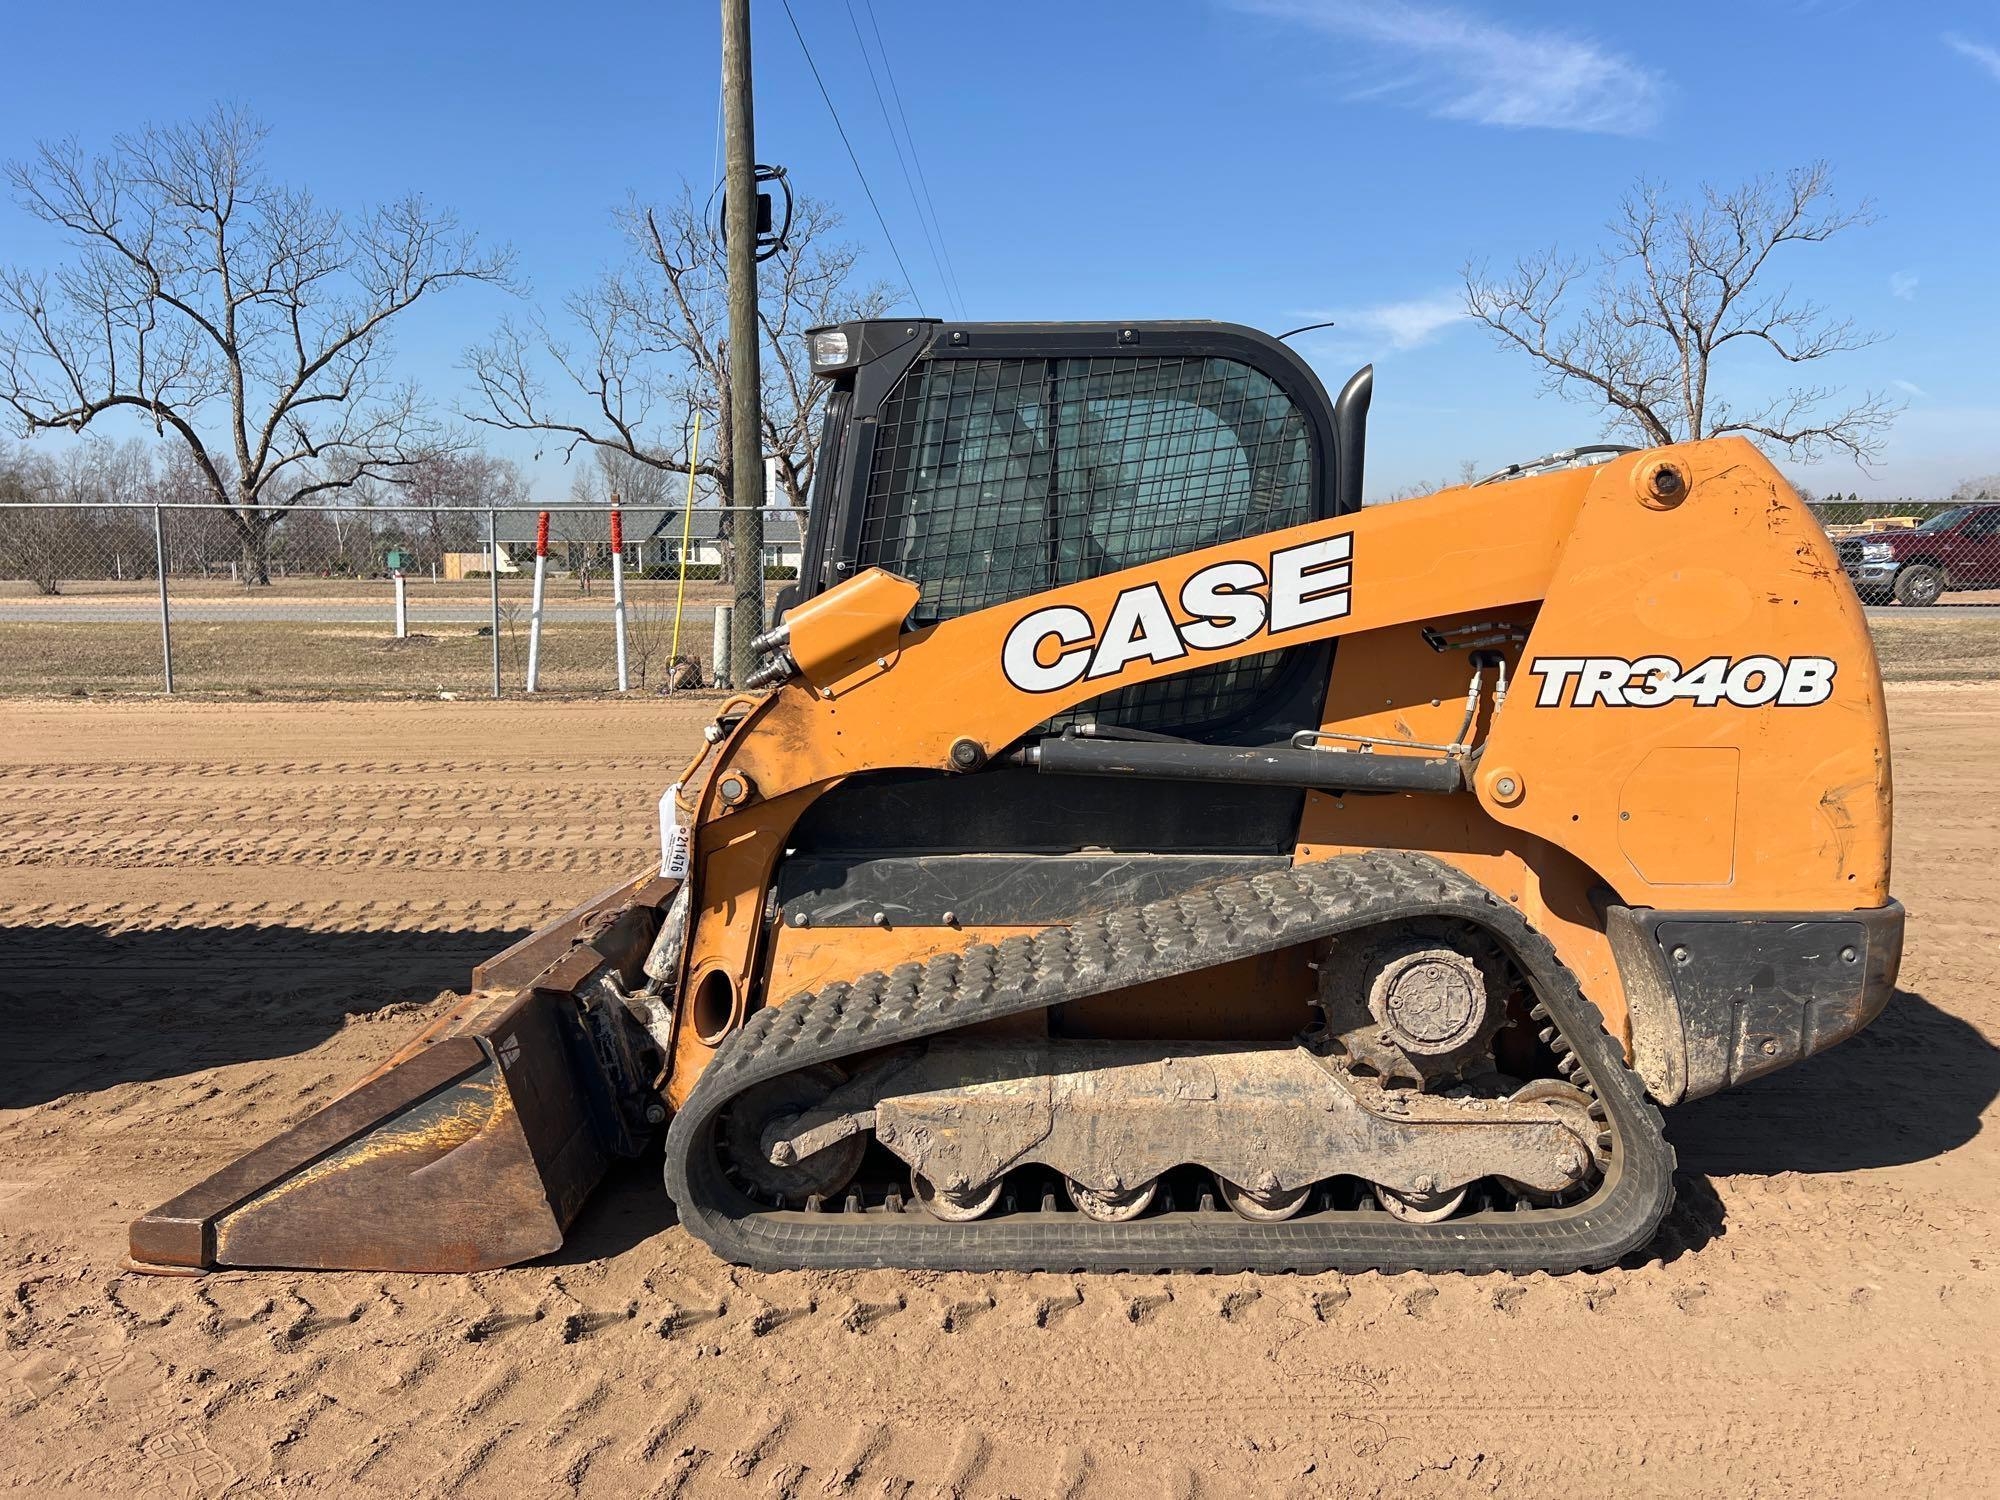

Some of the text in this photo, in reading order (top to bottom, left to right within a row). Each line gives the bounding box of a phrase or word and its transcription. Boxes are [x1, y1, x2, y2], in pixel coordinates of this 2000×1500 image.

[1001, 530, 1354, 694] CASE
[1529, 655, 1837, 708] TR340B
[671, 836, 689, 872] 211476
